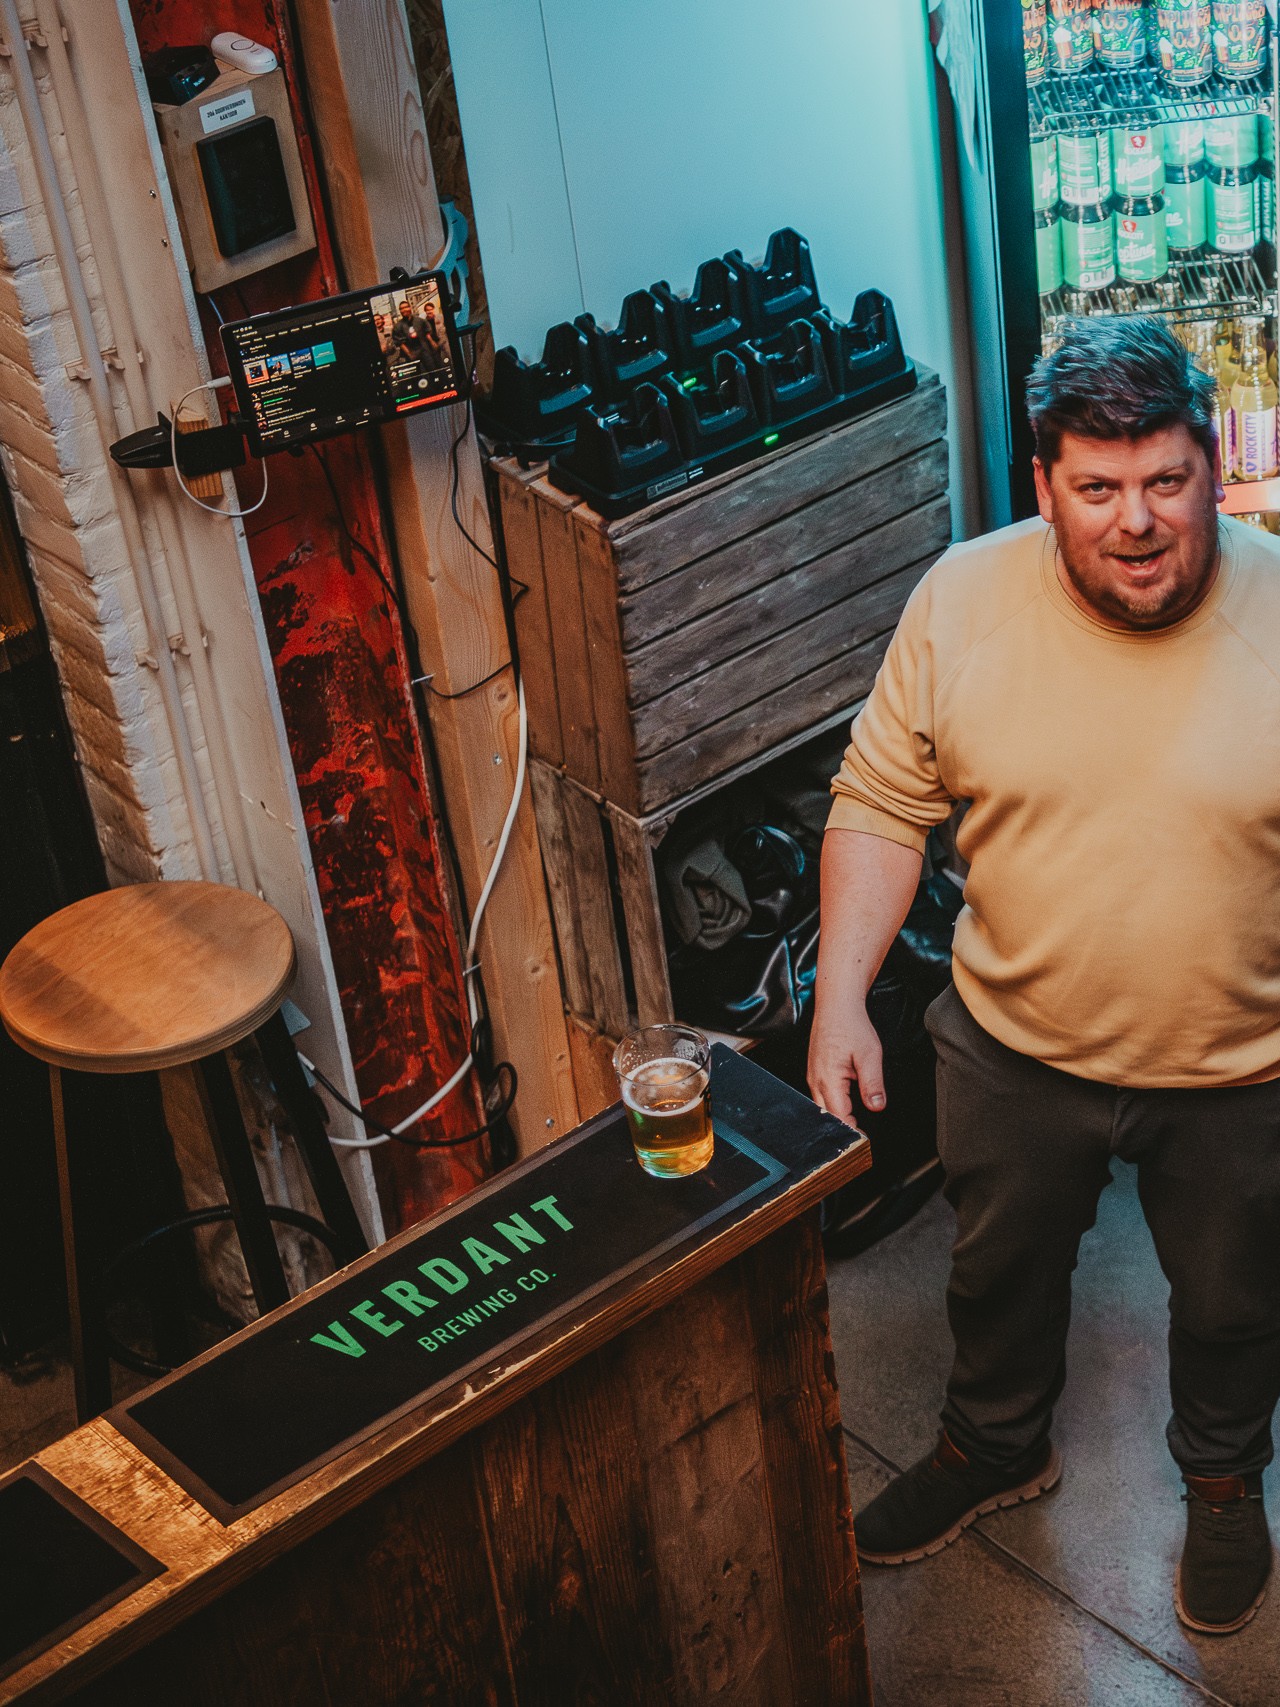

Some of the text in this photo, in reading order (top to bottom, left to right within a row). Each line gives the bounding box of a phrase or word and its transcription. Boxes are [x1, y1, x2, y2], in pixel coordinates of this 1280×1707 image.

[1244, 414, 1258, 460] ROCK CITY
[309, 1195, 574, 1358] VERDANT
[416, 1268, 558, 1353] BREWING CO.
